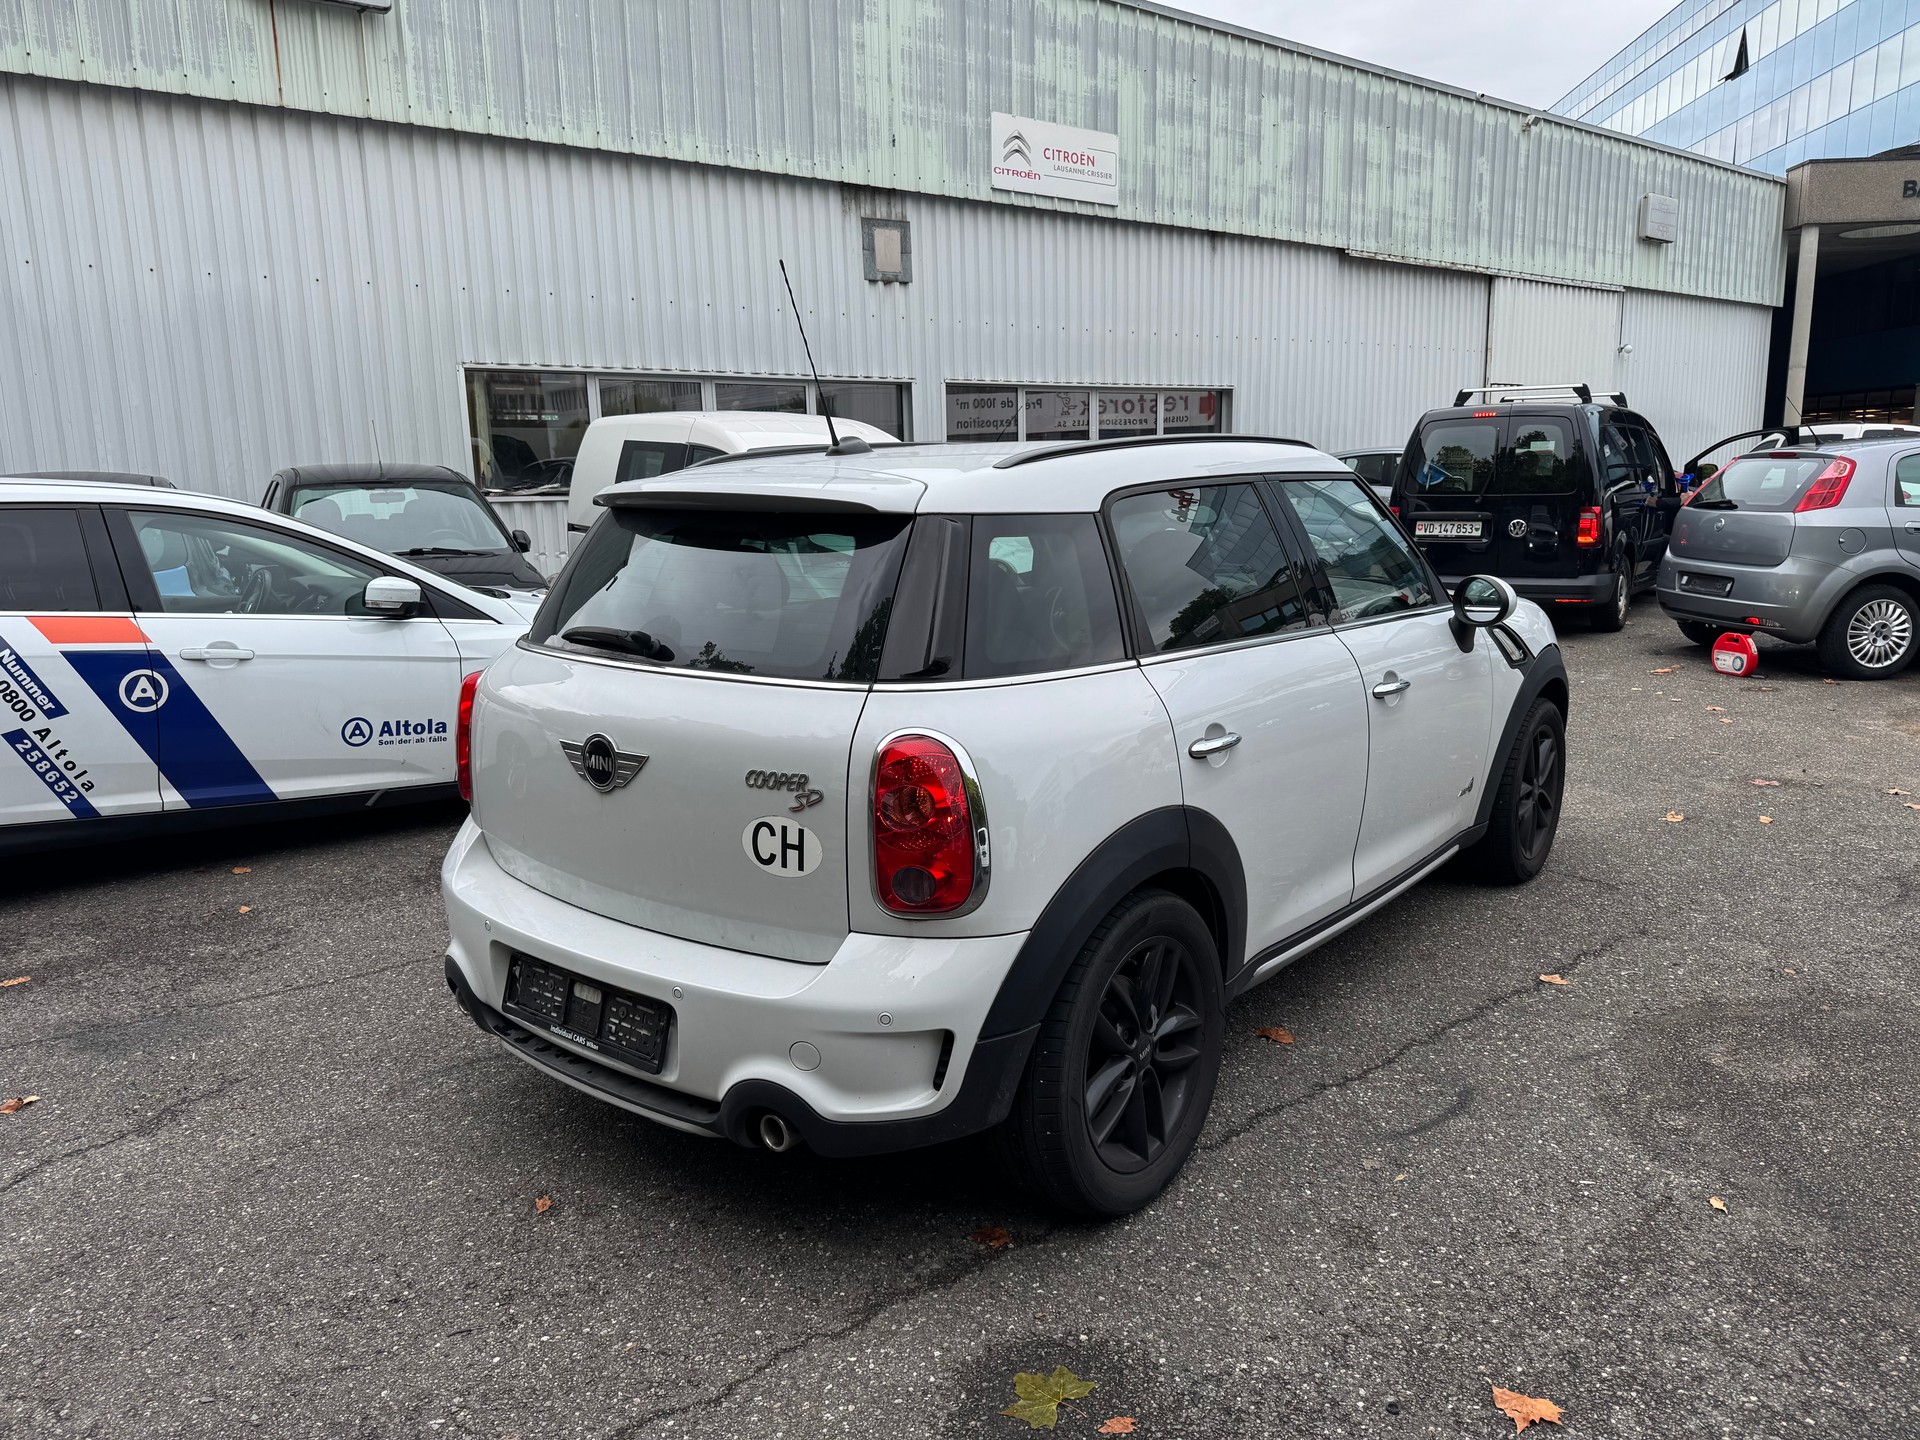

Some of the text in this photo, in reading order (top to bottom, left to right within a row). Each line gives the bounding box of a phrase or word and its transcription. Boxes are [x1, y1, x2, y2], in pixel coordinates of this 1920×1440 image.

[1043, 147, 1096, 168] CITROËN
[1053, 164, 1113, 180] LAUSANNE-CRISSIER
[0, 648, 56, 711] Nummer
[0, 679, 96, 793] 0800 Altola
[378, 718, 448, 738] Altola
[15, 739, 79, 804] 258652
[585, 753, 613, 772] MINI
[745, 769, 809, 792] COOPER
[752, 821, 805, 872] CH
[573, 1034, 586, 1045] CARS
